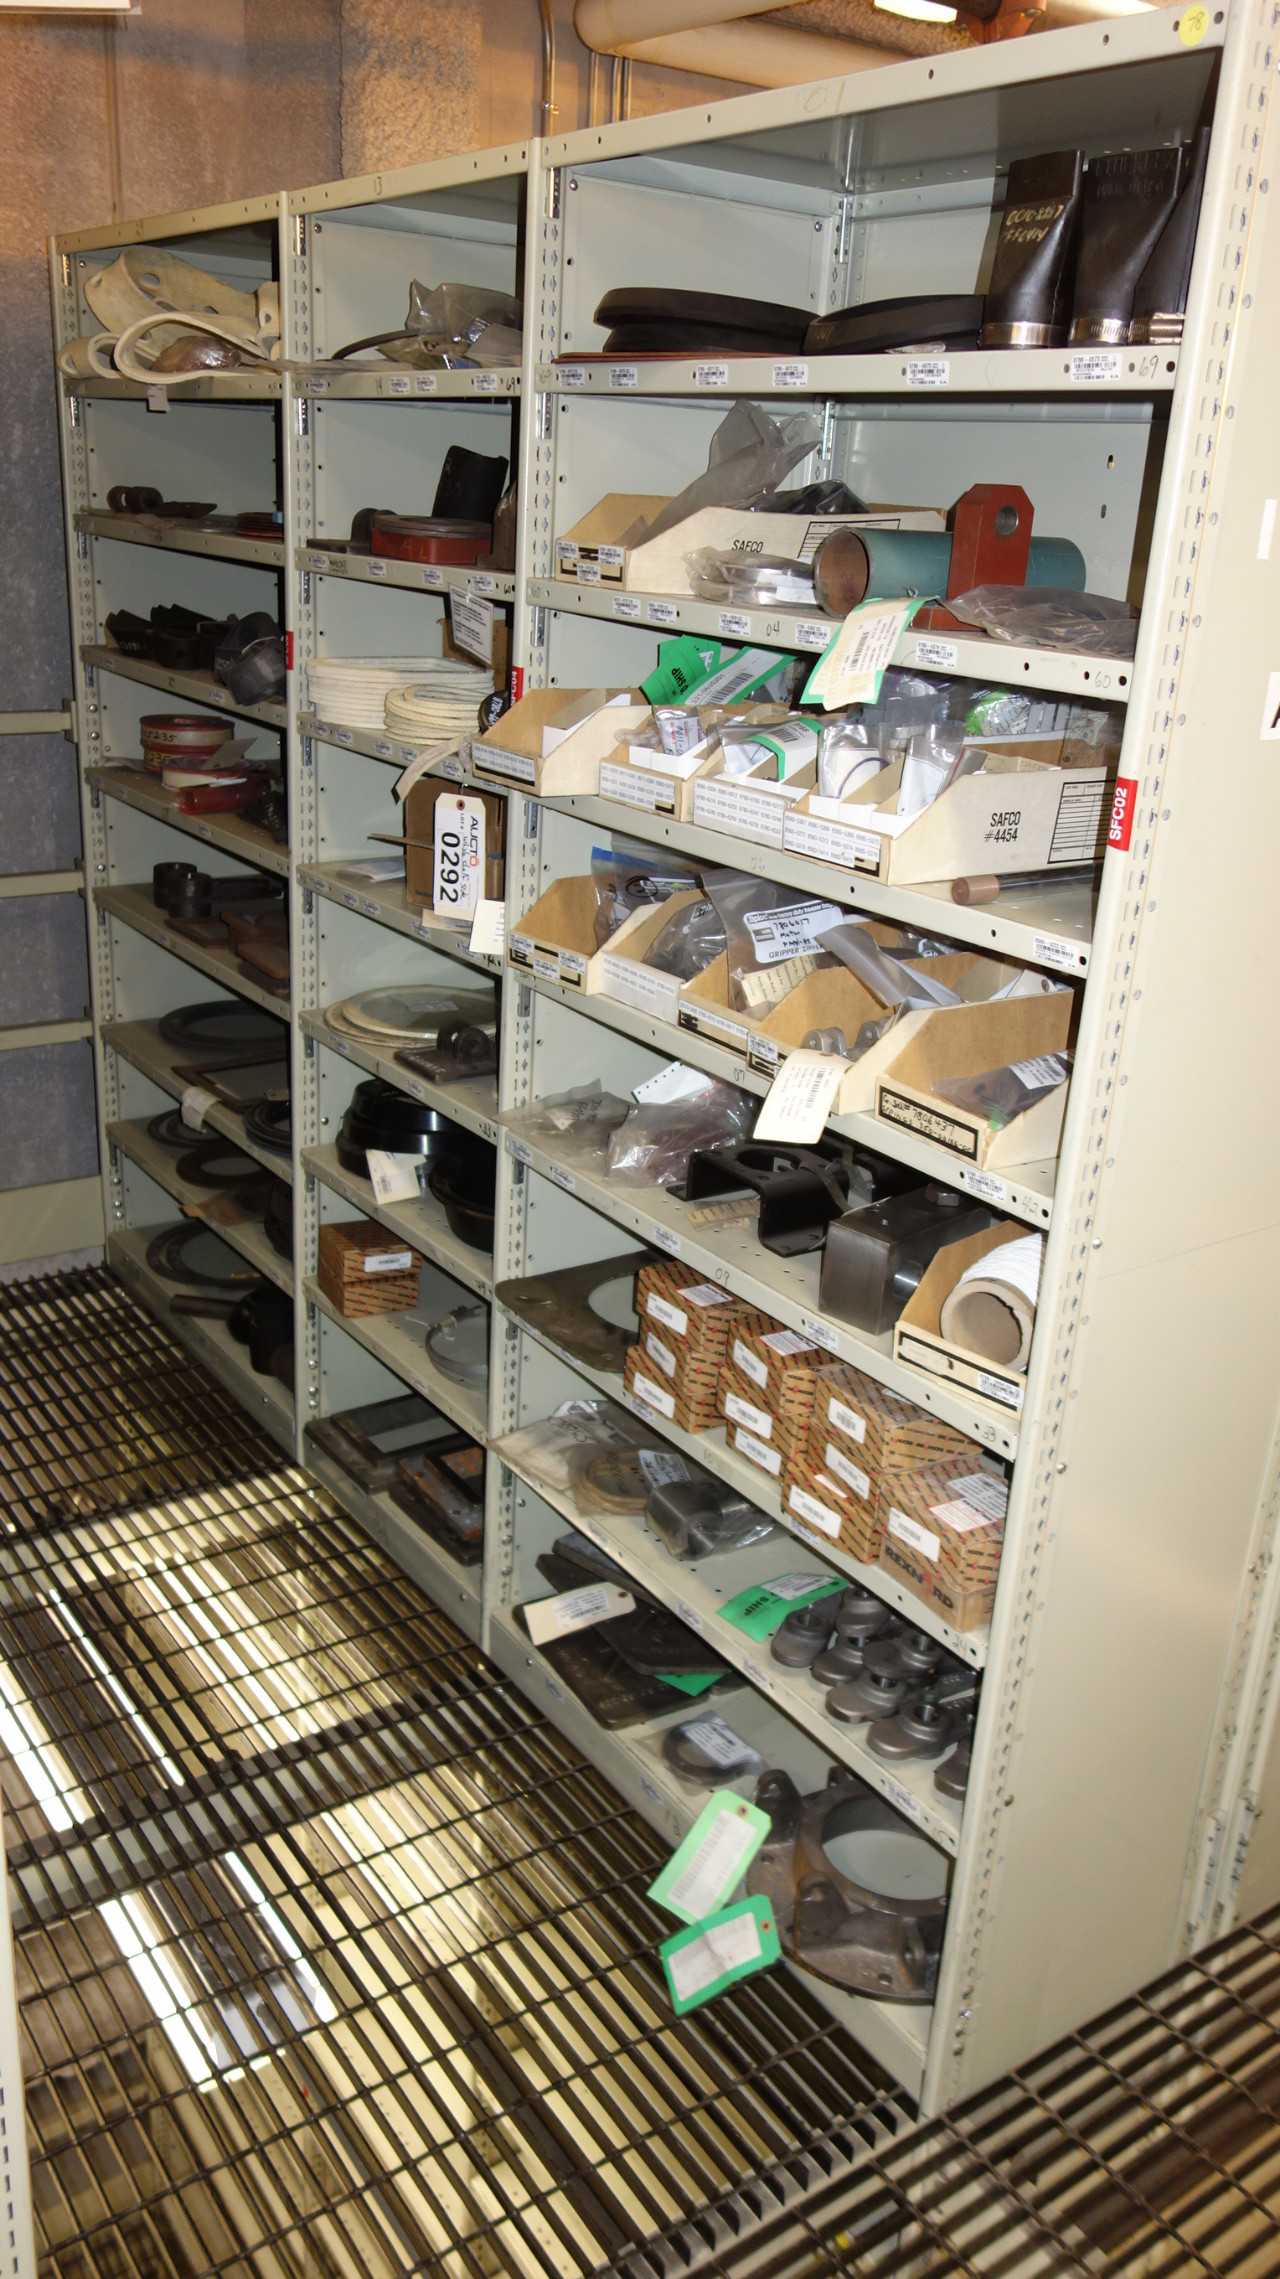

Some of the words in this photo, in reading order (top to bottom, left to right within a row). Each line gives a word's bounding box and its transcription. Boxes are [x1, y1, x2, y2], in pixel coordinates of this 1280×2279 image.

[731, 539, 764, 553] SAFCO
[990, 810, 1021, 827] SAFCO
[1109, 786, 1128, 841] SFC02
[469, 815, 480, 868] AUCTO
[984, 827, 1018, 843] #4454
[440, 832, 461, 903] 0292
